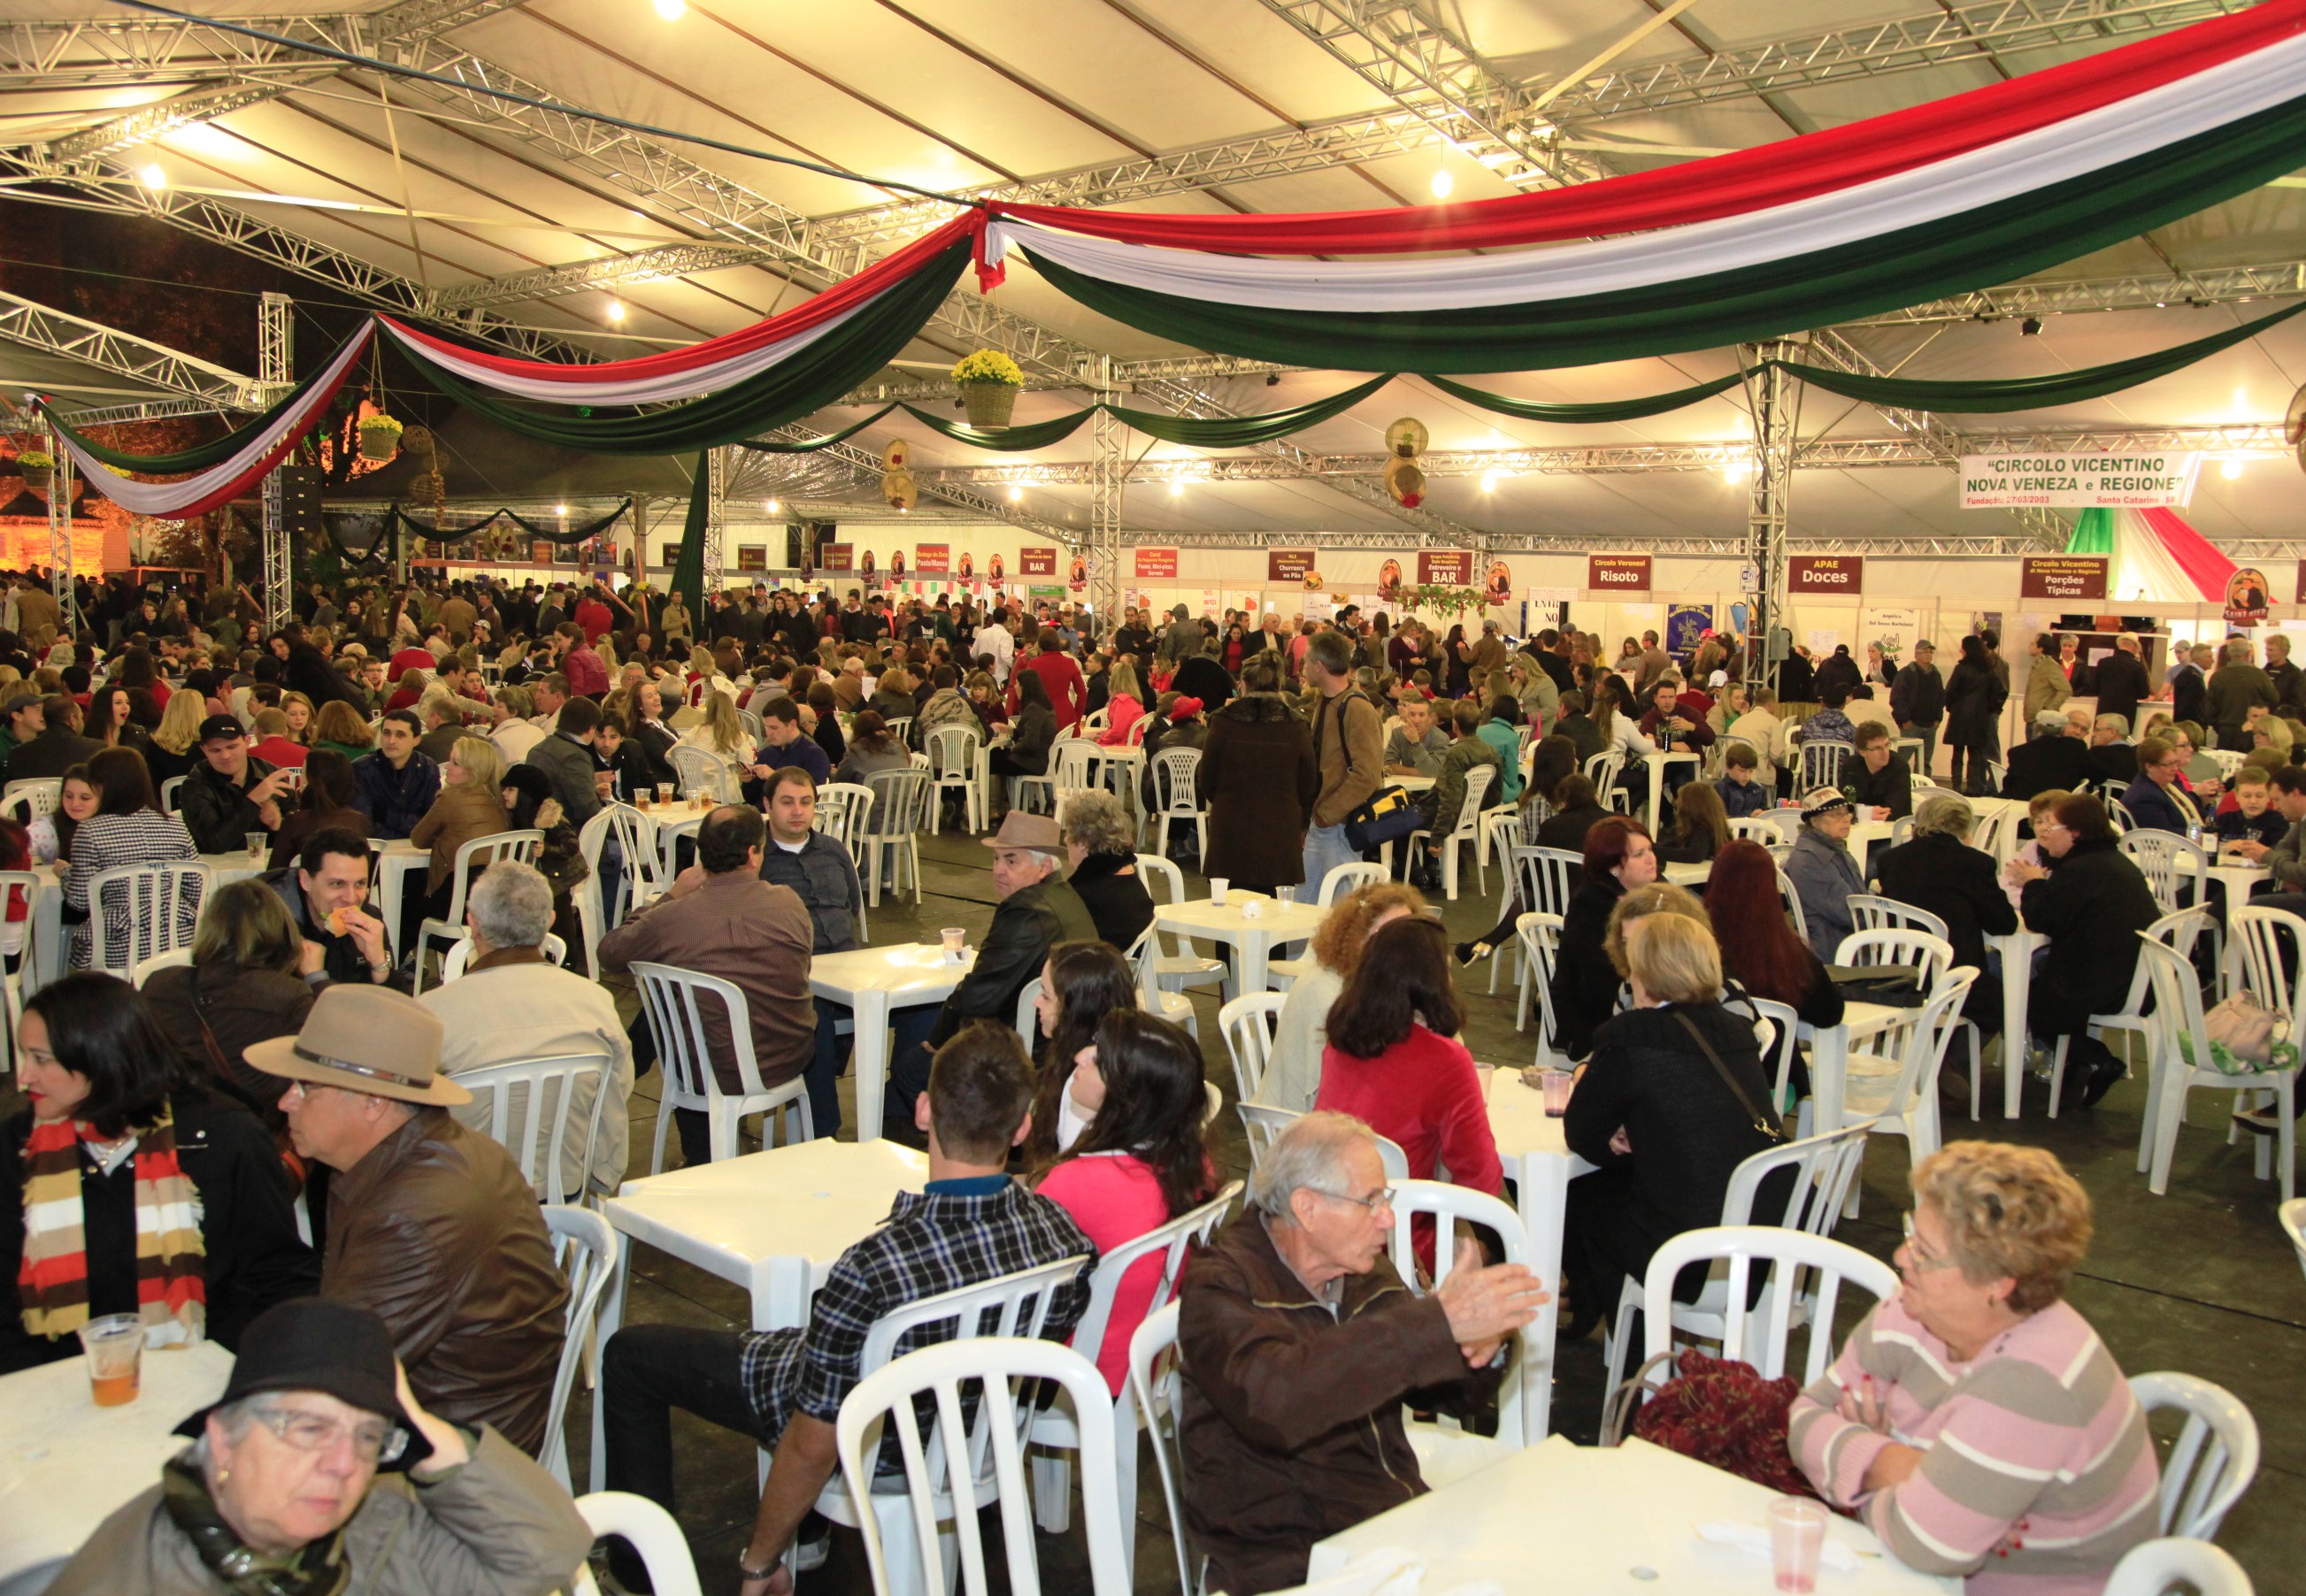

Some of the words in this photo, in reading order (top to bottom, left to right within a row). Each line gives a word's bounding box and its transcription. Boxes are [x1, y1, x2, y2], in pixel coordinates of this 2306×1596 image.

[2072, 458, 2164, 472] VICENTINO
[1967, 479, 2008, 492] NOVA
[2013, 478, 2078, 491] VENEZA
[2086, 481, 2094, 491] e
[1029, 563, 1045, 572] BAR
[1432, 572, 1457, 583] BAR
[1600, 571, 1639, 582] Risoto
[1803, 570, 1849, 583] Doces
[2045, 576, 2085, 586] Porções
[2046, 586, 2081, 596] Típicas
